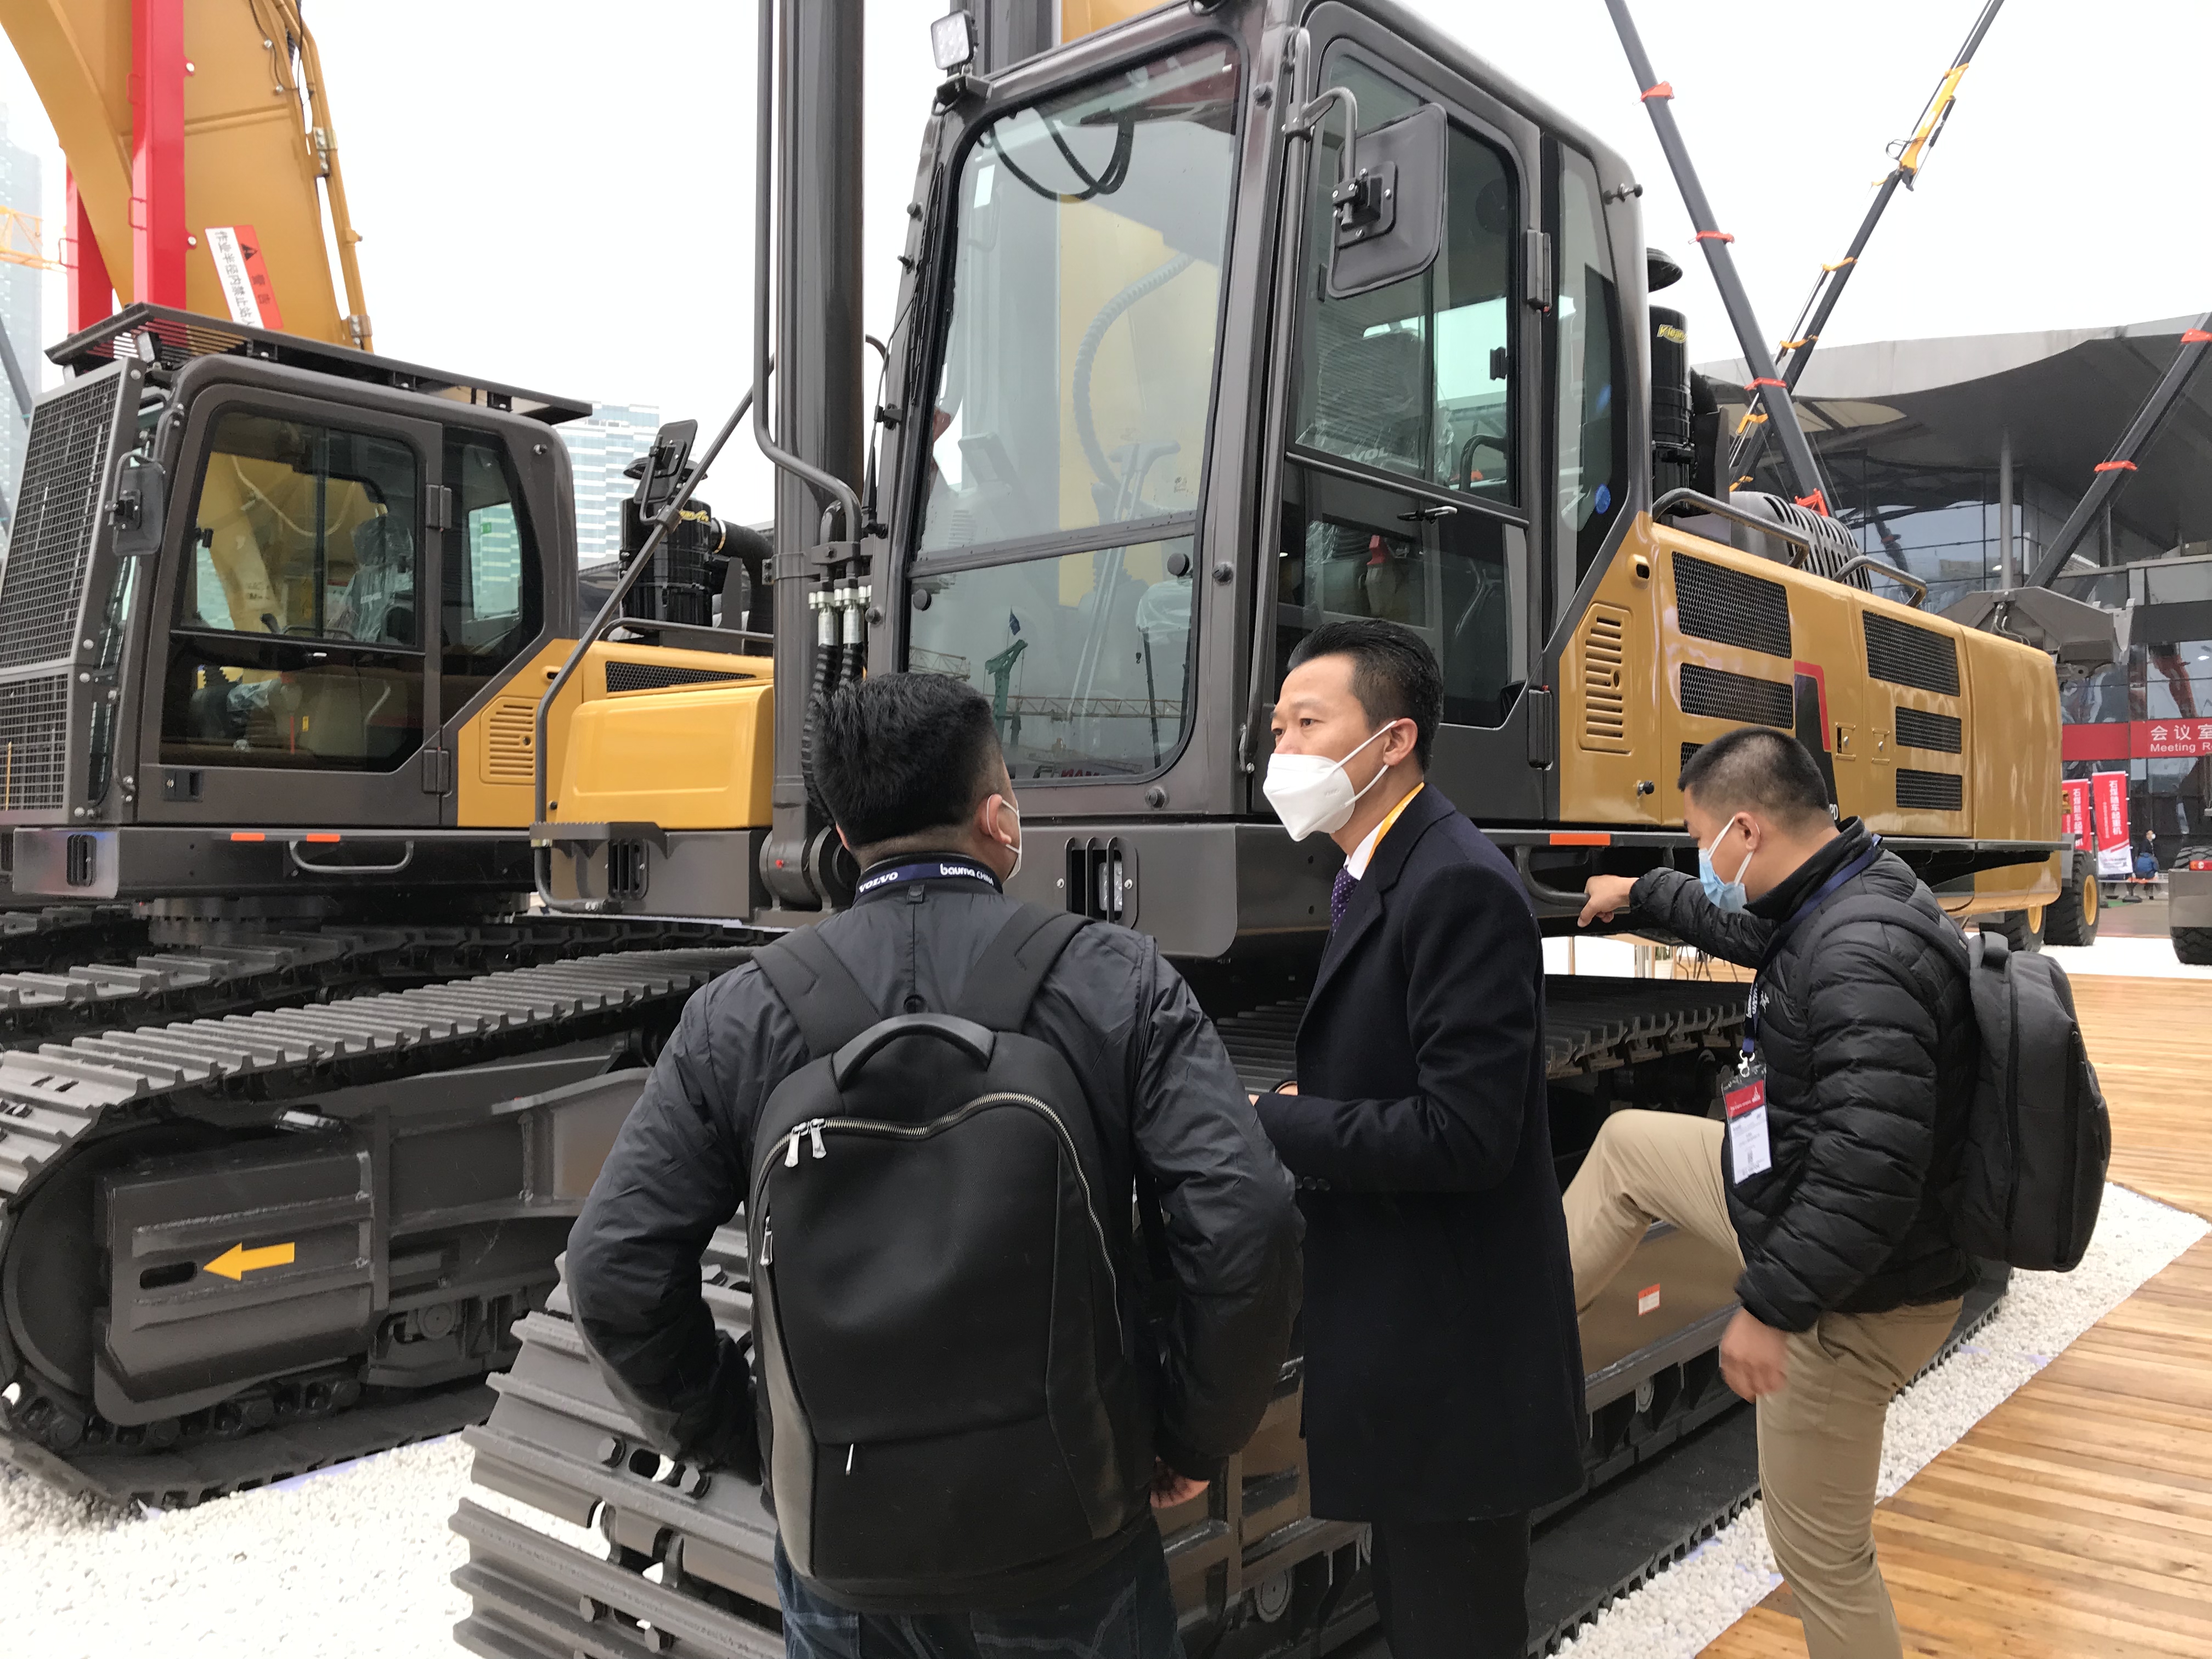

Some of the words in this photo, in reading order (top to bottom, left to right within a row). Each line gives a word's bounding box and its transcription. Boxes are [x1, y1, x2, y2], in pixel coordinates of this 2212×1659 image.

[2151, 724, 2212, 741] 会议室
[2150, 743, 2196, 753] Meeting
[2202, 742, 2212, 751] R
[859, 871, 898, 893] VOLVO
[940, 863, 975, 877] bauma
[976, 870, 994, 886] CHINA
